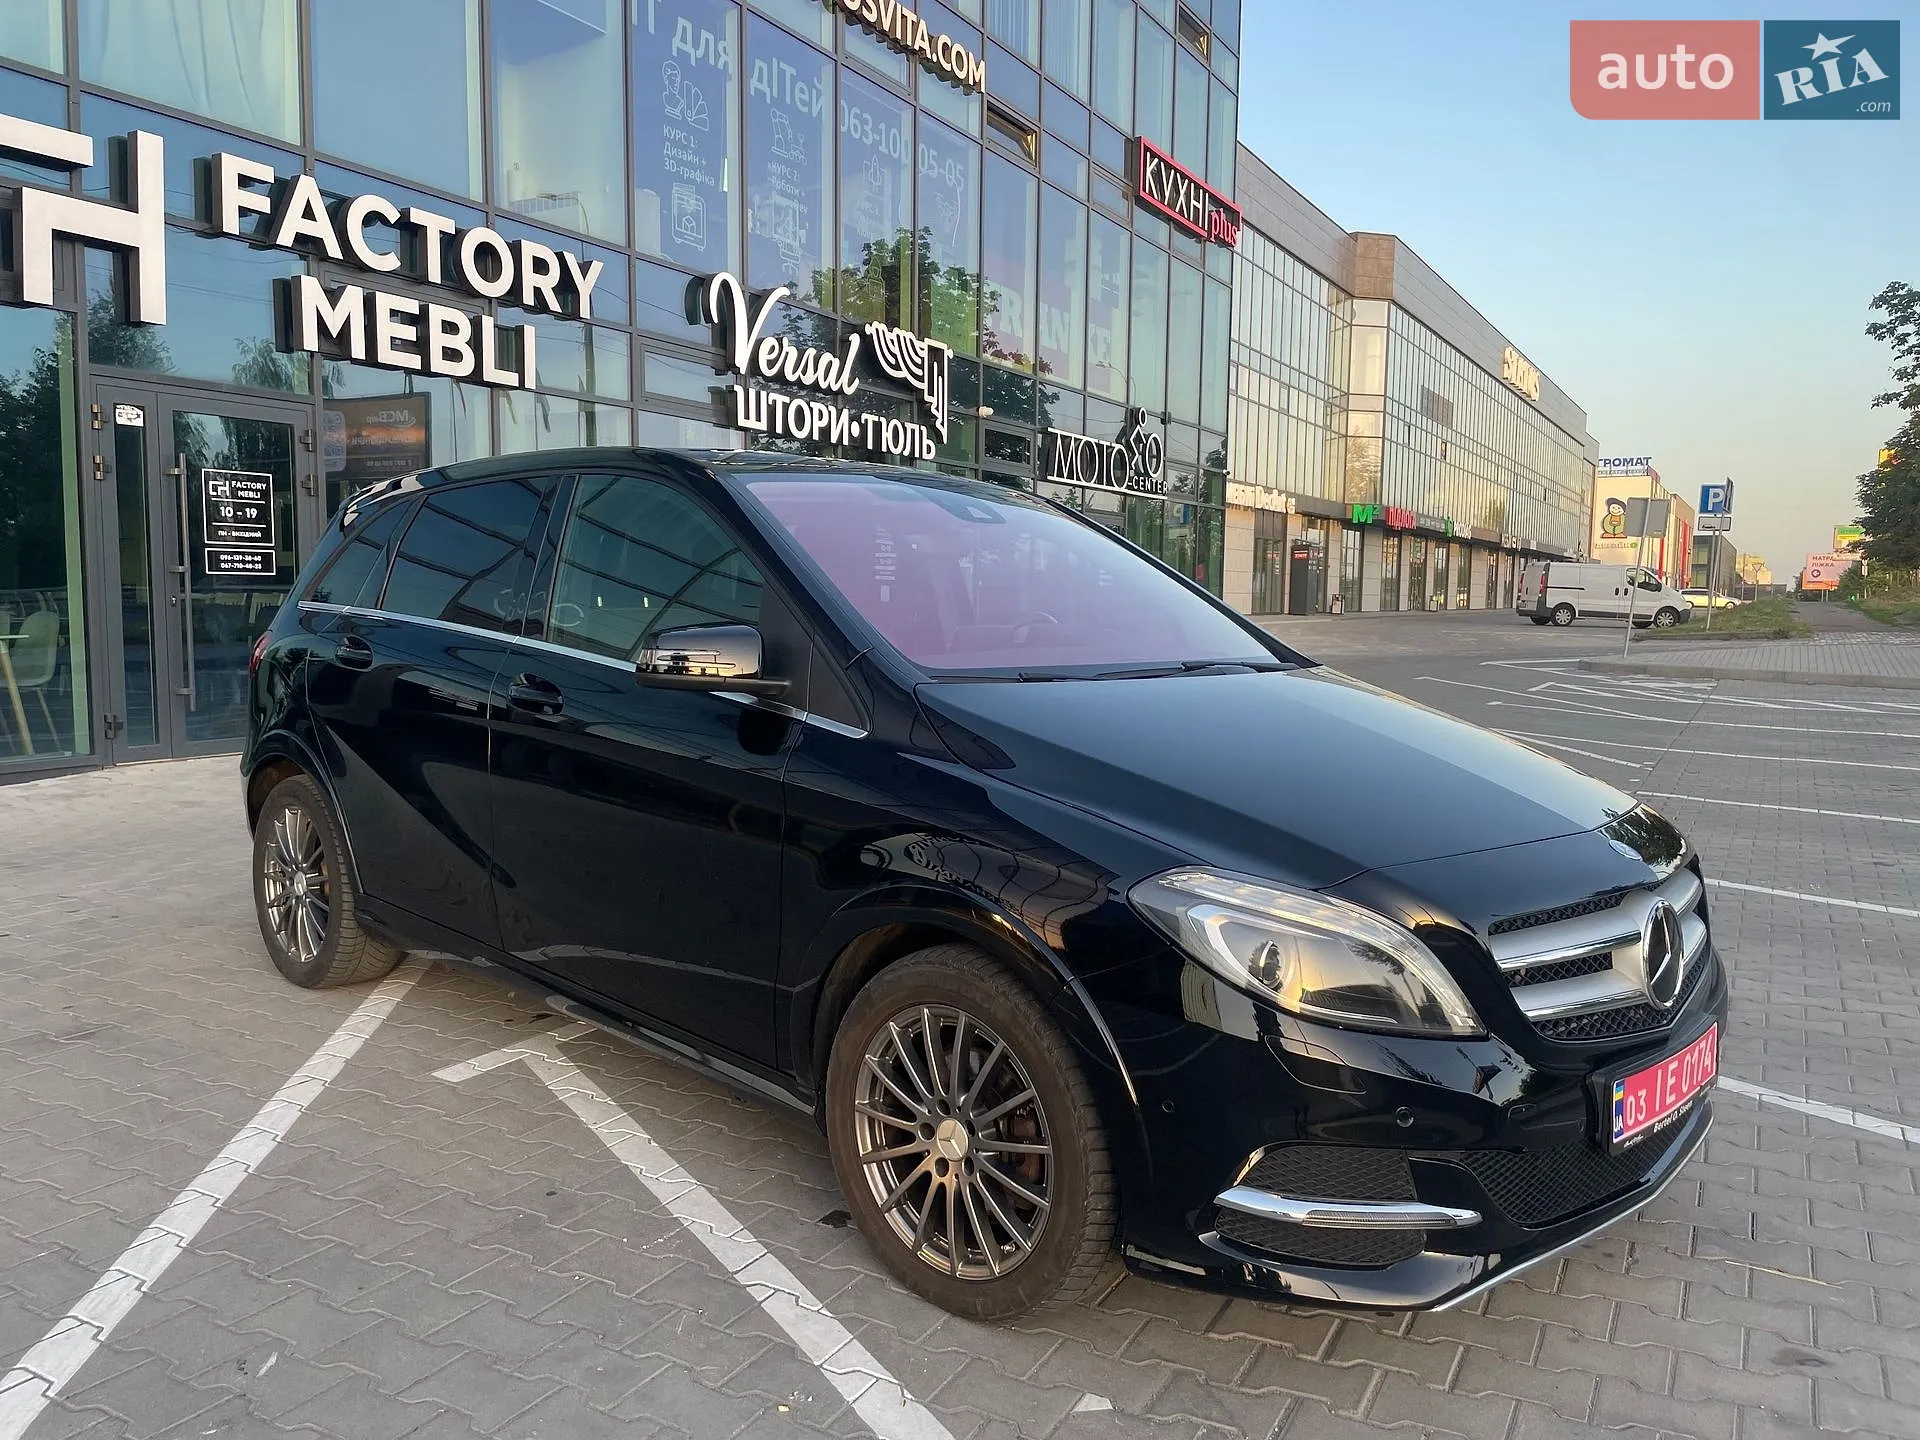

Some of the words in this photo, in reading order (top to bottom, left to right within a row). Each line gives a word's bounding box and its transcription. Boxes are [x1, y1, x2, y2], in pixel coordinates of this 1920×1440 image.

[843, 0, 985, 94] SVITA.COM
[663, 124, 688, 145] КУРС
[664, 141, 699, 165] Дизайн
[664, 157, 715, 186] 3D-графіка
[1145, 151, 1209, 231] КУХНІ
[1209, 207, 1238, 246] plus
[212, 152, 604, 319] FACTORY
[298, 275, 536, 390] MEBLI
[710, 272, 861, 395] Versal
[1051, 430, 1129, 491] MOTO
[231, 480, 267, 490] FACTORY
[238, 490, 260, 499] MEBLI
[1707, 487, 1725, 511] P
[220, 506, 234, 517] 10
[245, 508, 258, 519] 19
[1626, 1088, 1647, 1127] 03
[1613, 1113, 1624, 1132] UA
